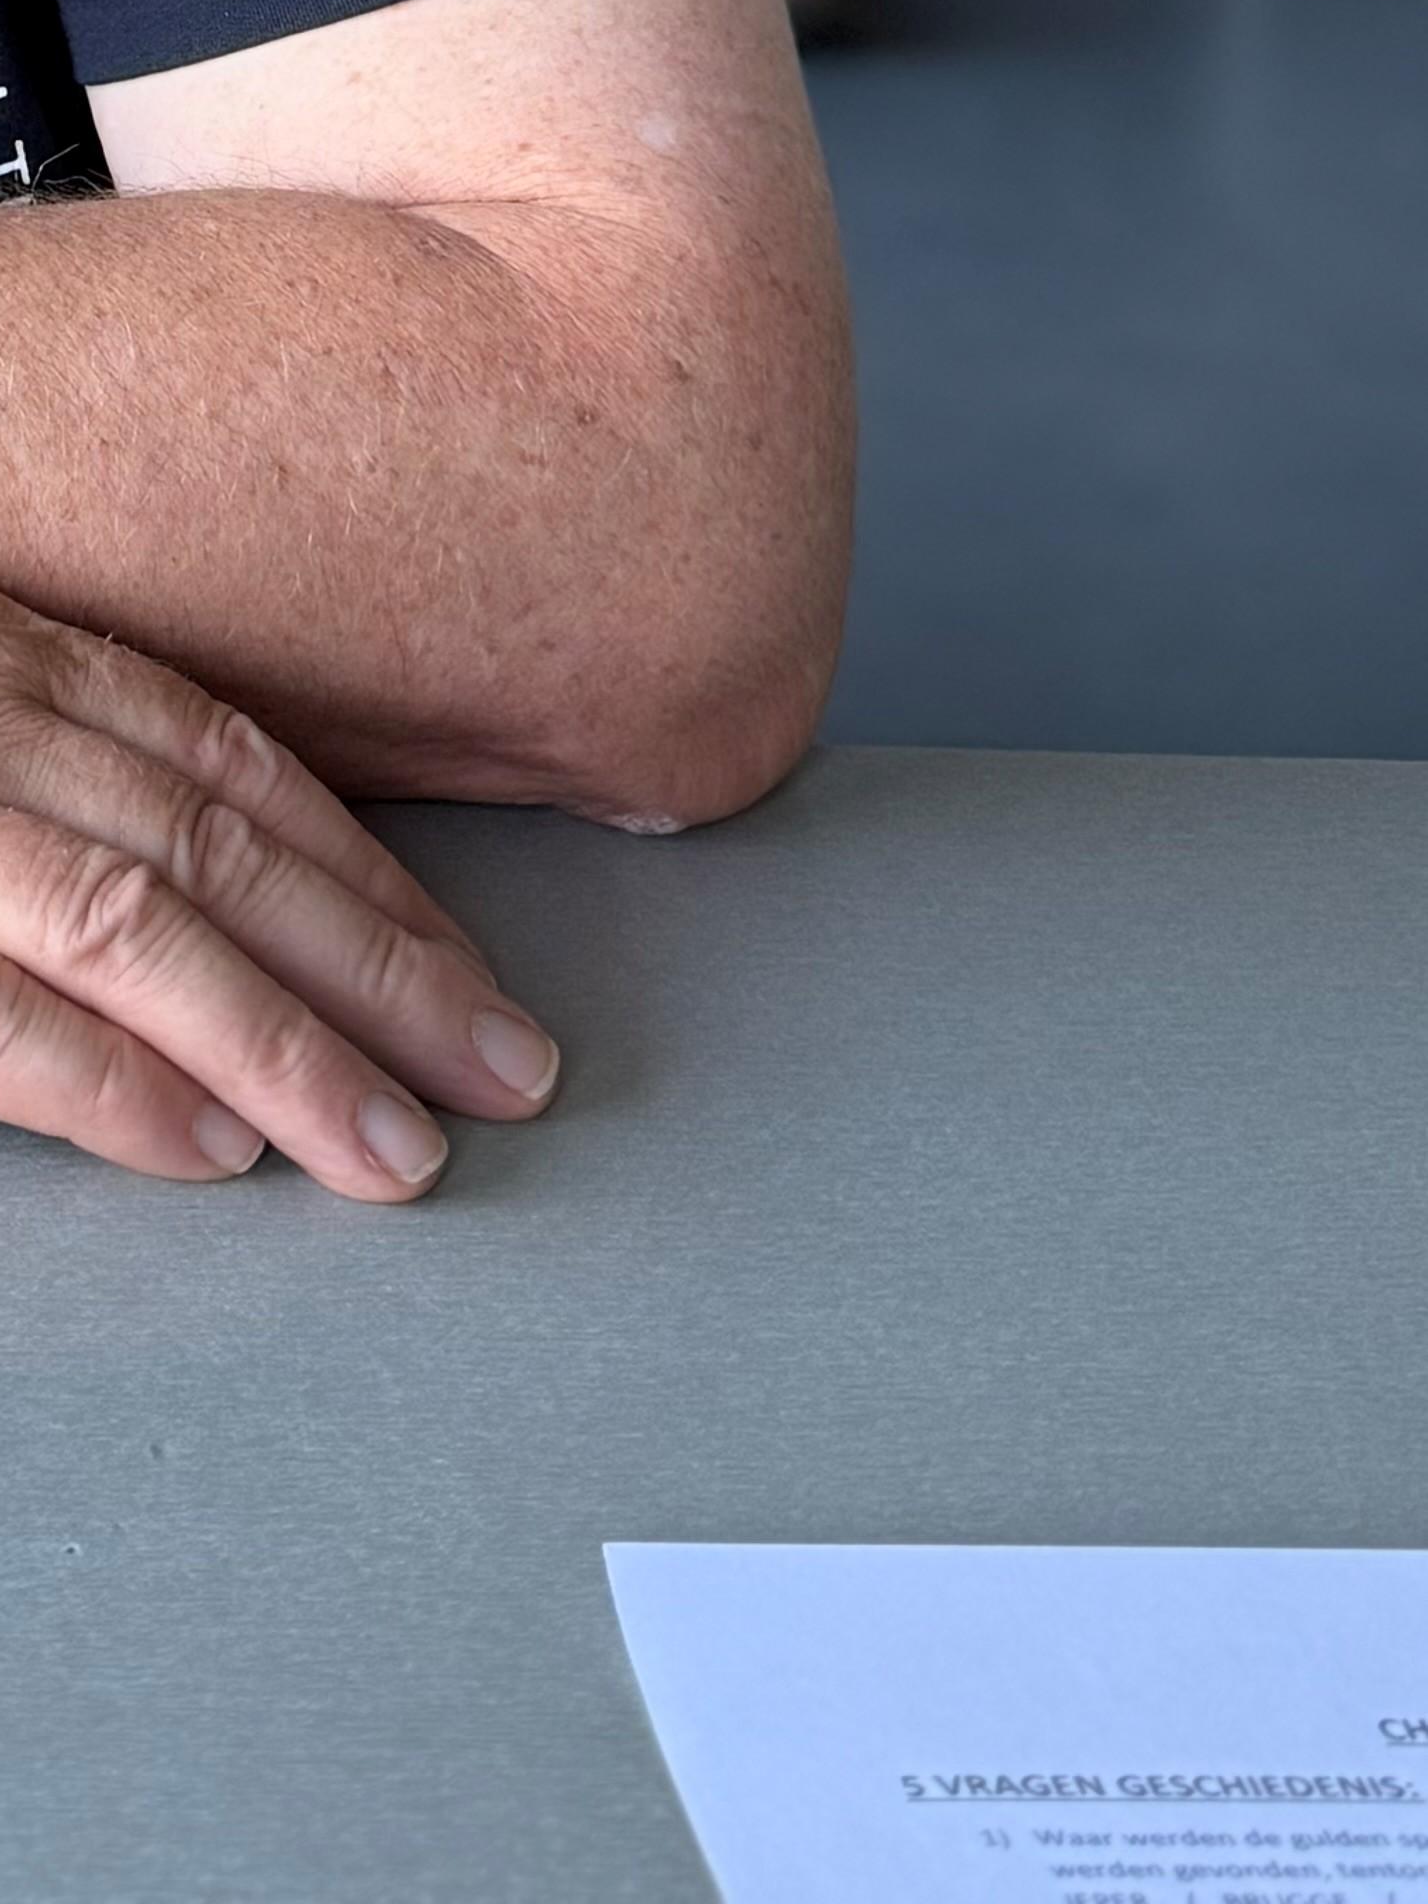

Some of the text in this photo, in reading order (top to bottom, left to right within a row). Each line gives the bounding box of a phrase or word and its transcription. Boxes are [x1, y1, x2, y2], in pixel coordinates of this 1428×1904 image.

[900, 1773, 1420, 1799] 5 VRAGEN GESCHIEDENIS:
[980, 1827, 1013, 1851] 1)
[1032, 1827, 1112, 1847] Waar
[1122, 1828, 1236, 1848] werden
[1244, 1827, 1281, 1848] de
[1290, 1827, 1390, 1851] gulden
[1049, 1859, 1165, 1879] werden
[1173, 1859, 1332, 1883] gevonden,
